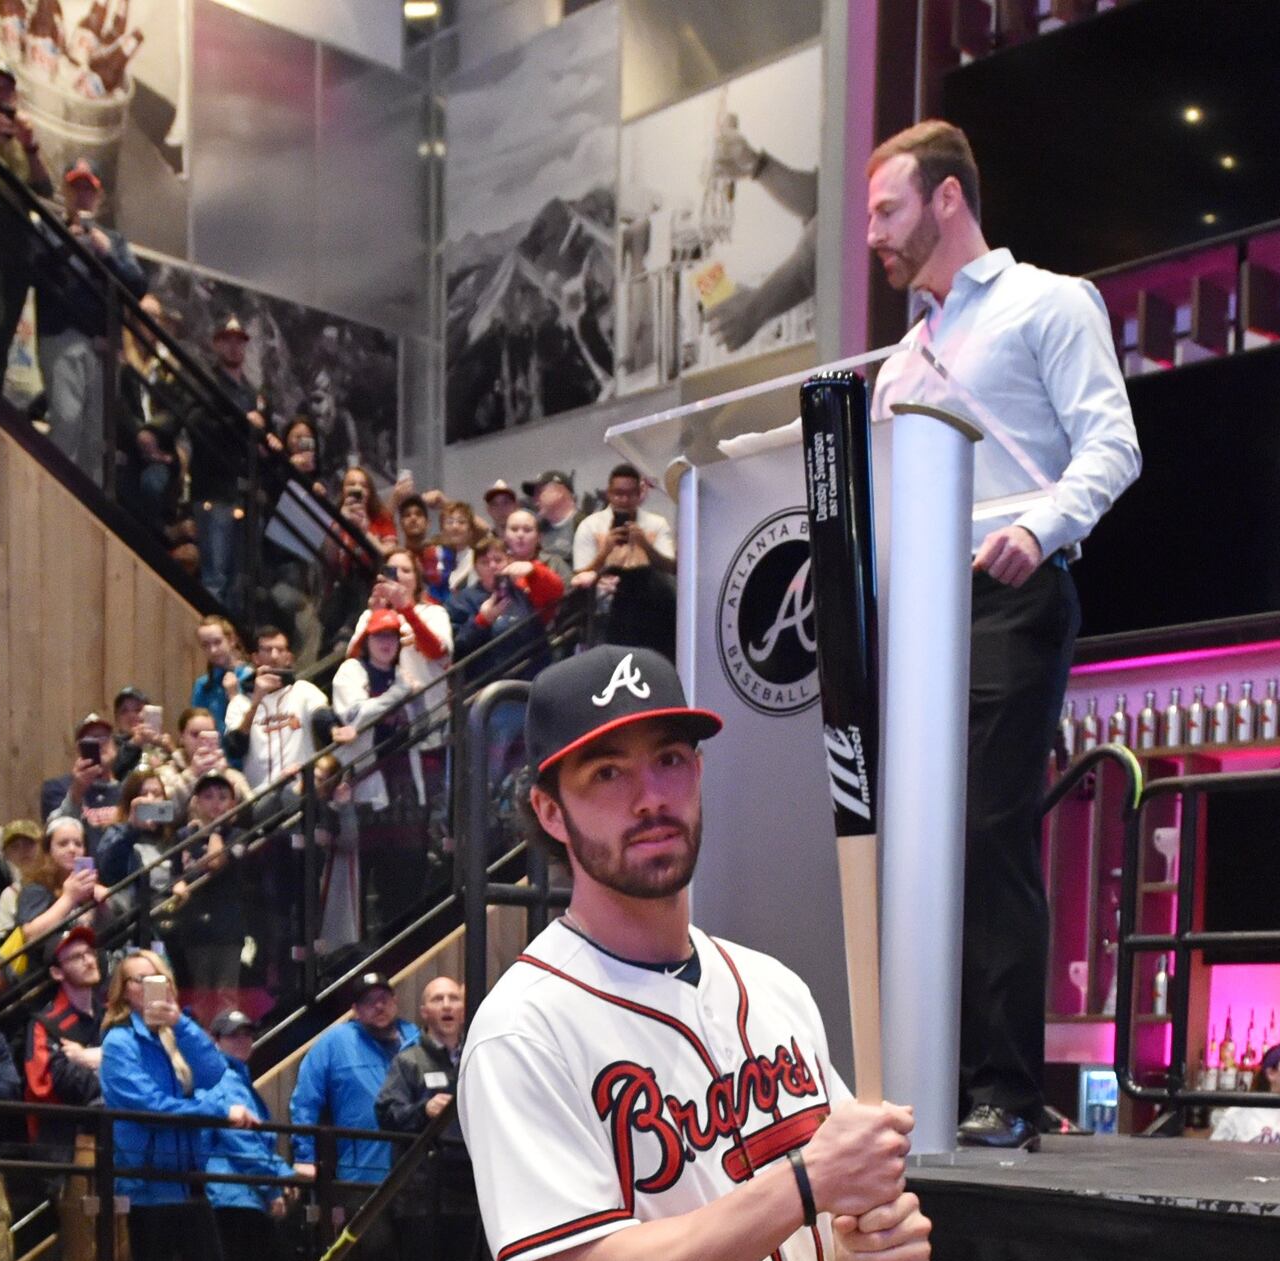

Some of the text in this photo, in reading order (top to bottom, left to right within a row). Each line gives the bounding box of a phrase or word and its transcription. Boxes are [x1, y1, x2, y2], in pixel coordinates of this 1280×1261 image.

[814, 432, 829, 521] Dansby Swanson
[827, 446, 836, 462] Cut
[728, 523, 789, 608] ATLANTA
[591, 653, 651, 707] A
[727, 644, 810, 701] BASEBALL
[847, 725, 870, 804] marucci
[591, 1035, 819, 1214] Braves
